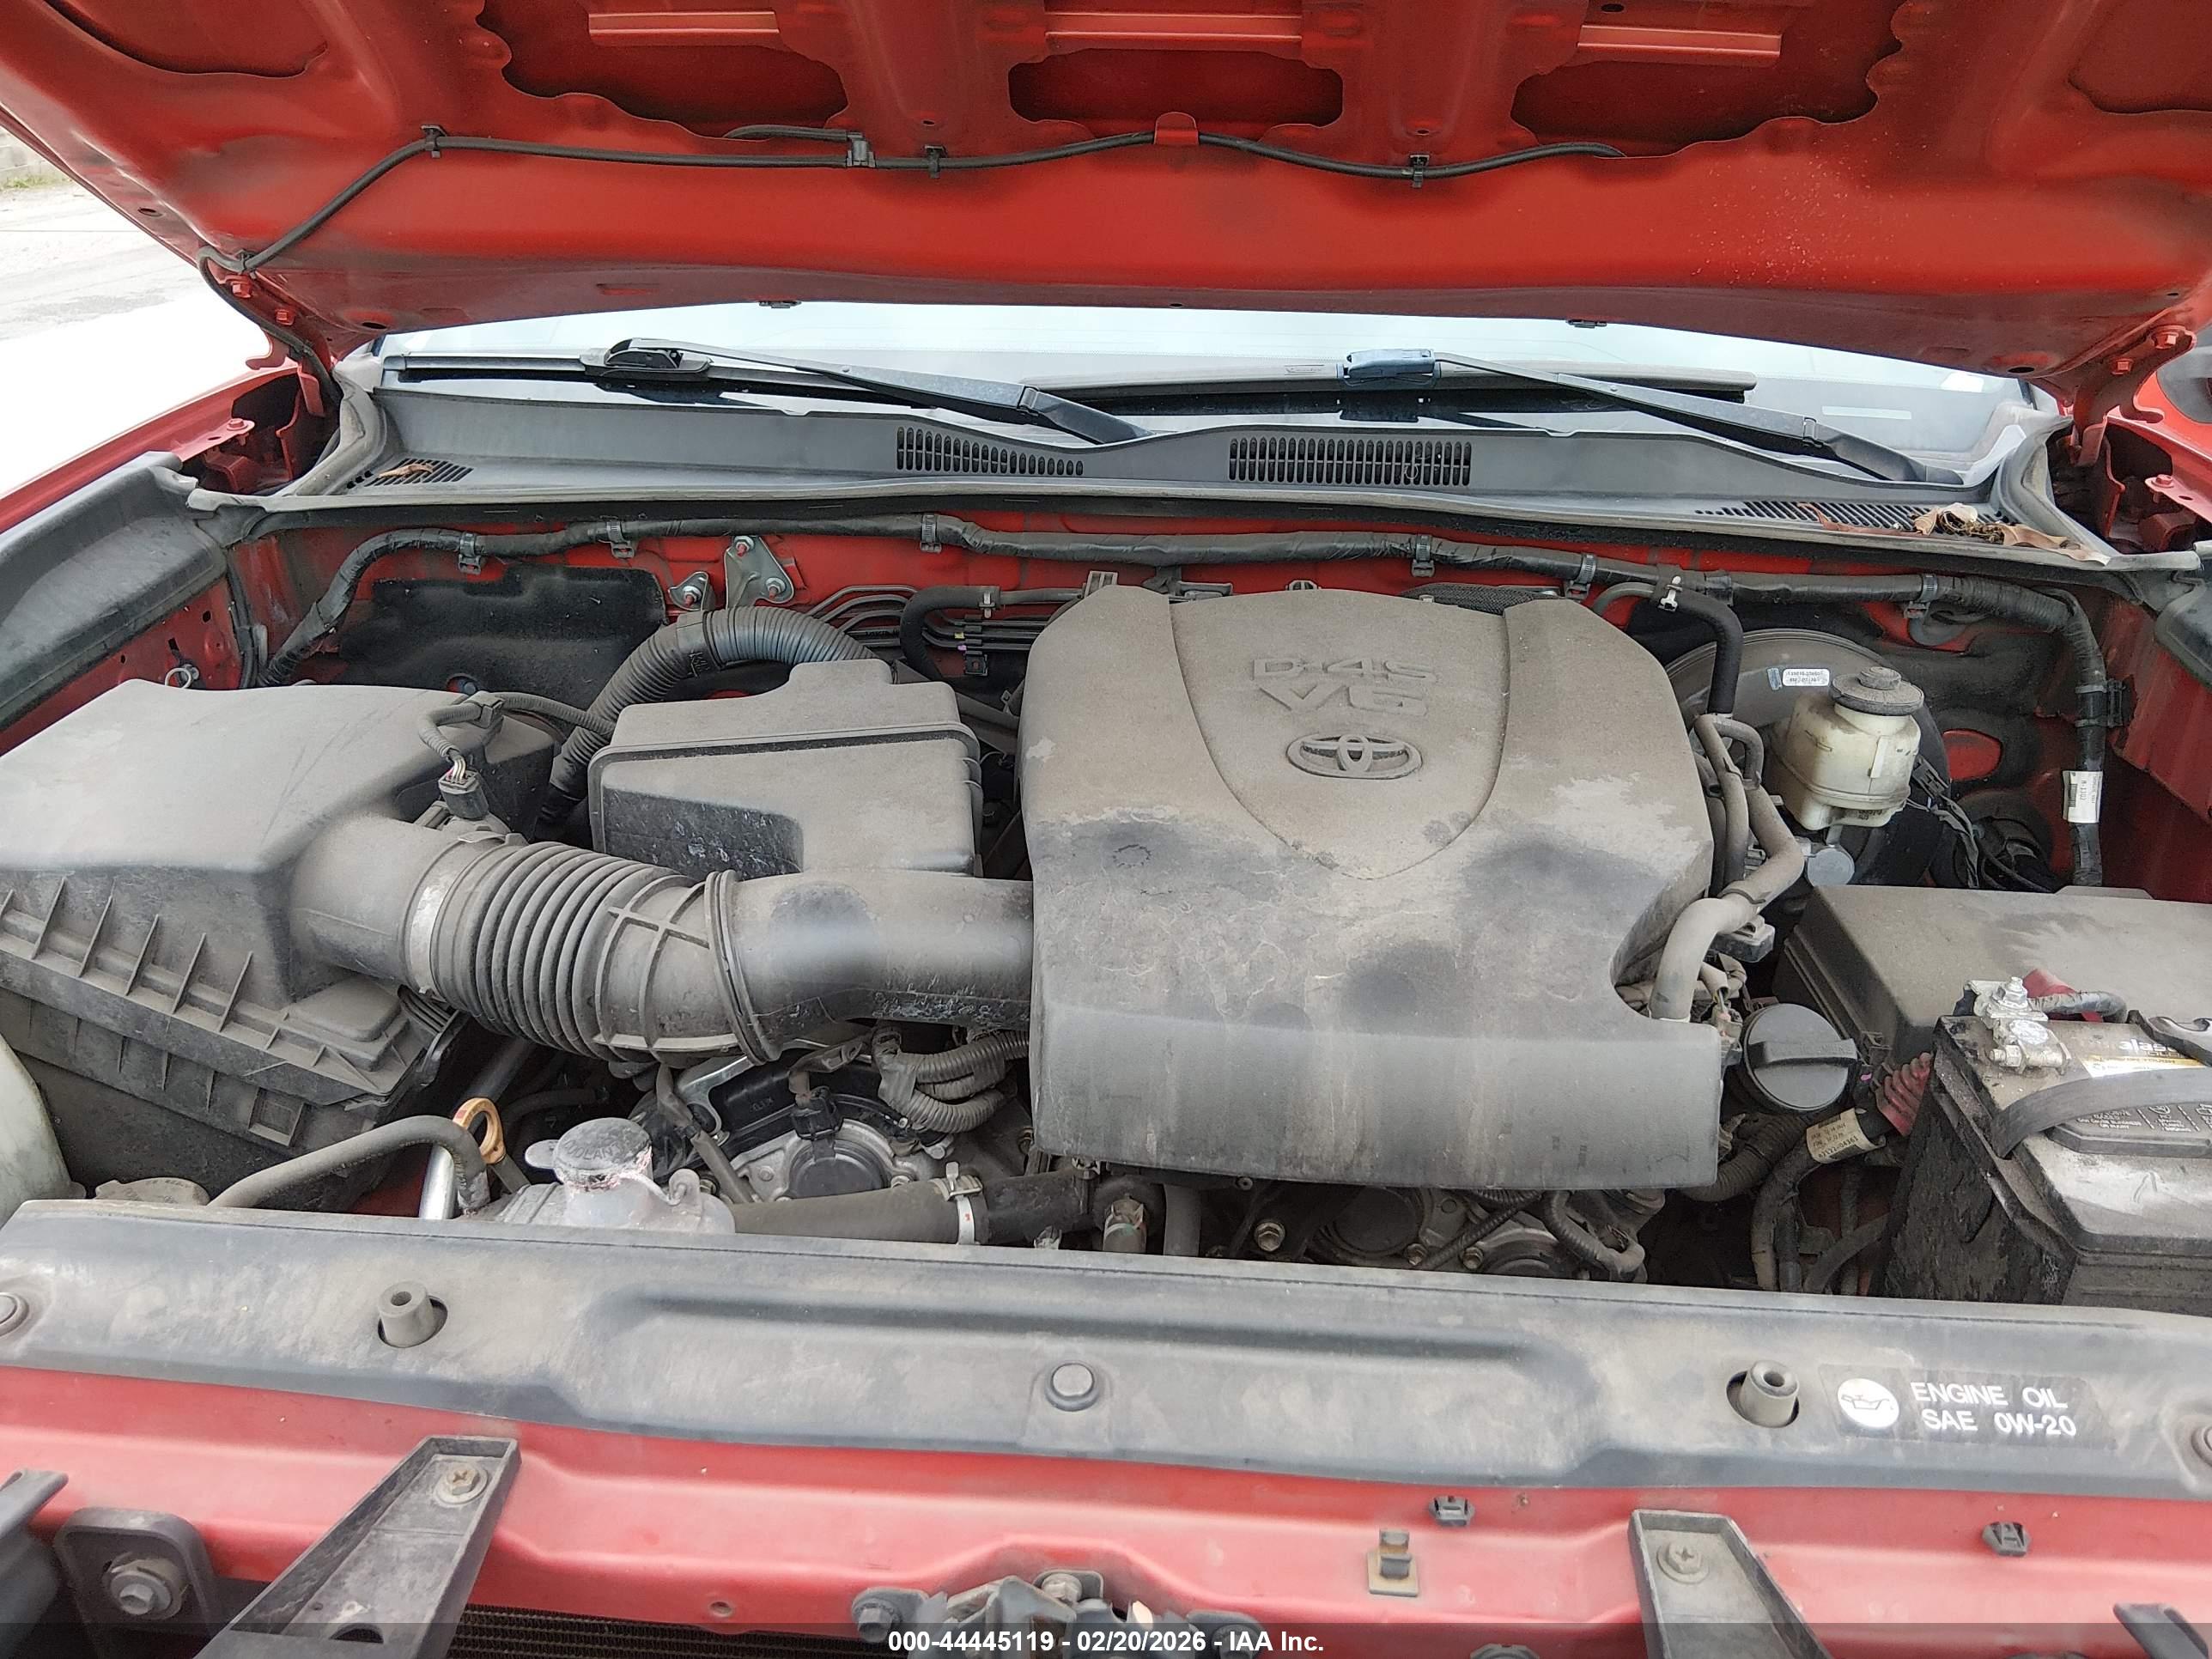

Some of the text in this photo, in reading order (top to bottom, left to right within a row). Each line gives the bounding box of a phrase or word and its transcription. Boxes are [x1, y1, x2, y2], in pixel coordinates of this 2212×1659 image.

[1256, 681, 1429, 716] V6
[1910, 1382, 2069, 1409] ENGINE OIL
[1921, 1408, 2078, 1437] SAE 0W-20
